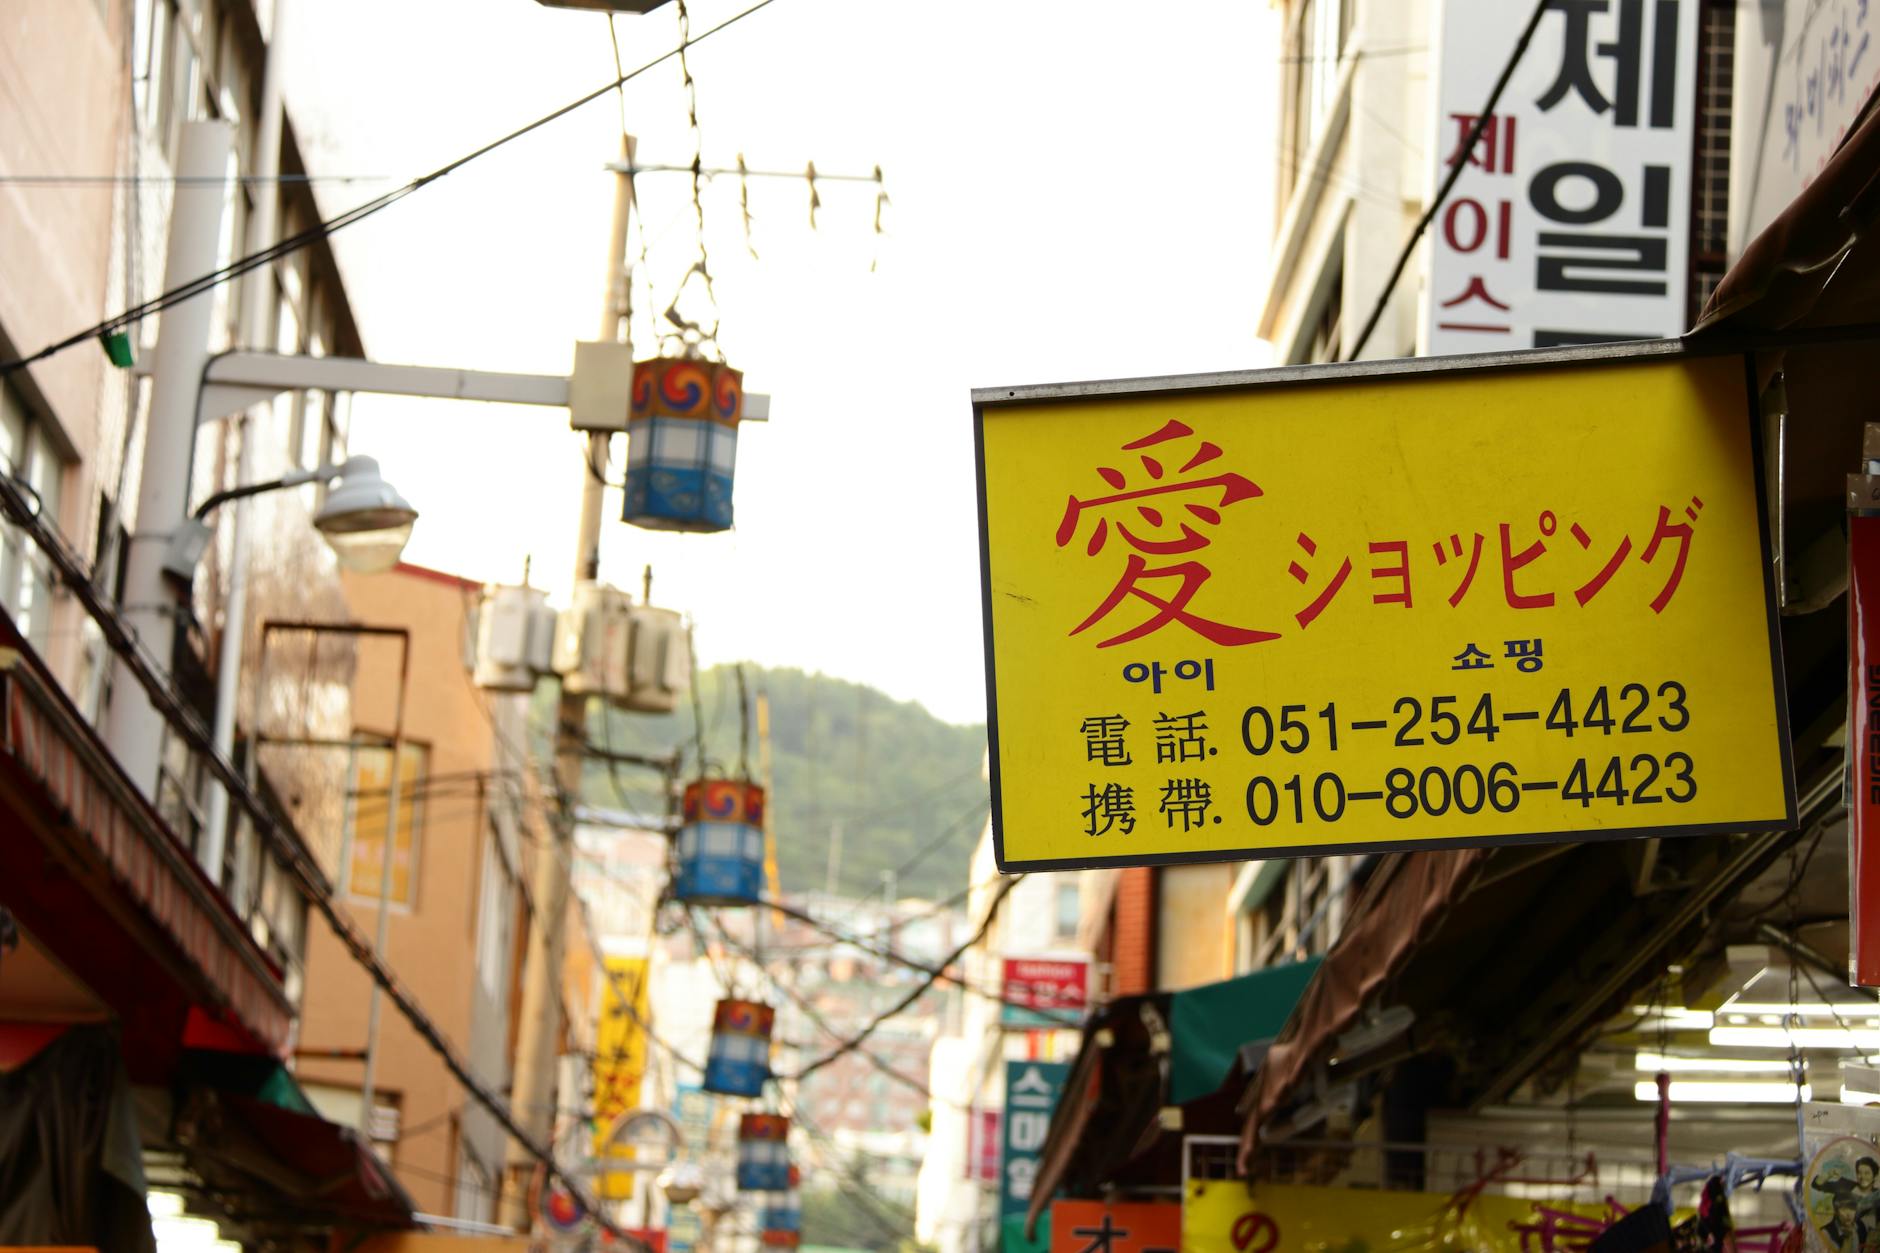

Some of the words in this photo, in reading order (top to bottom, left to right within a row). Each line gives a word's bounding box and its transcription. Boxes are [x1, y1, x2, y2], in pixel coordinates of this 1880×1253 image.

[1528, 0, 1680, 348] 제일
[1054, 418, 1283, 649] 愛
[1122, 658, 1216, 694] 아이
[1452, 638, 1545, 673] 쇼핑
[1241, 680, 1691, 757] 051-254-4423
[1246, 751, 1699, 827] 010-8006-4423
